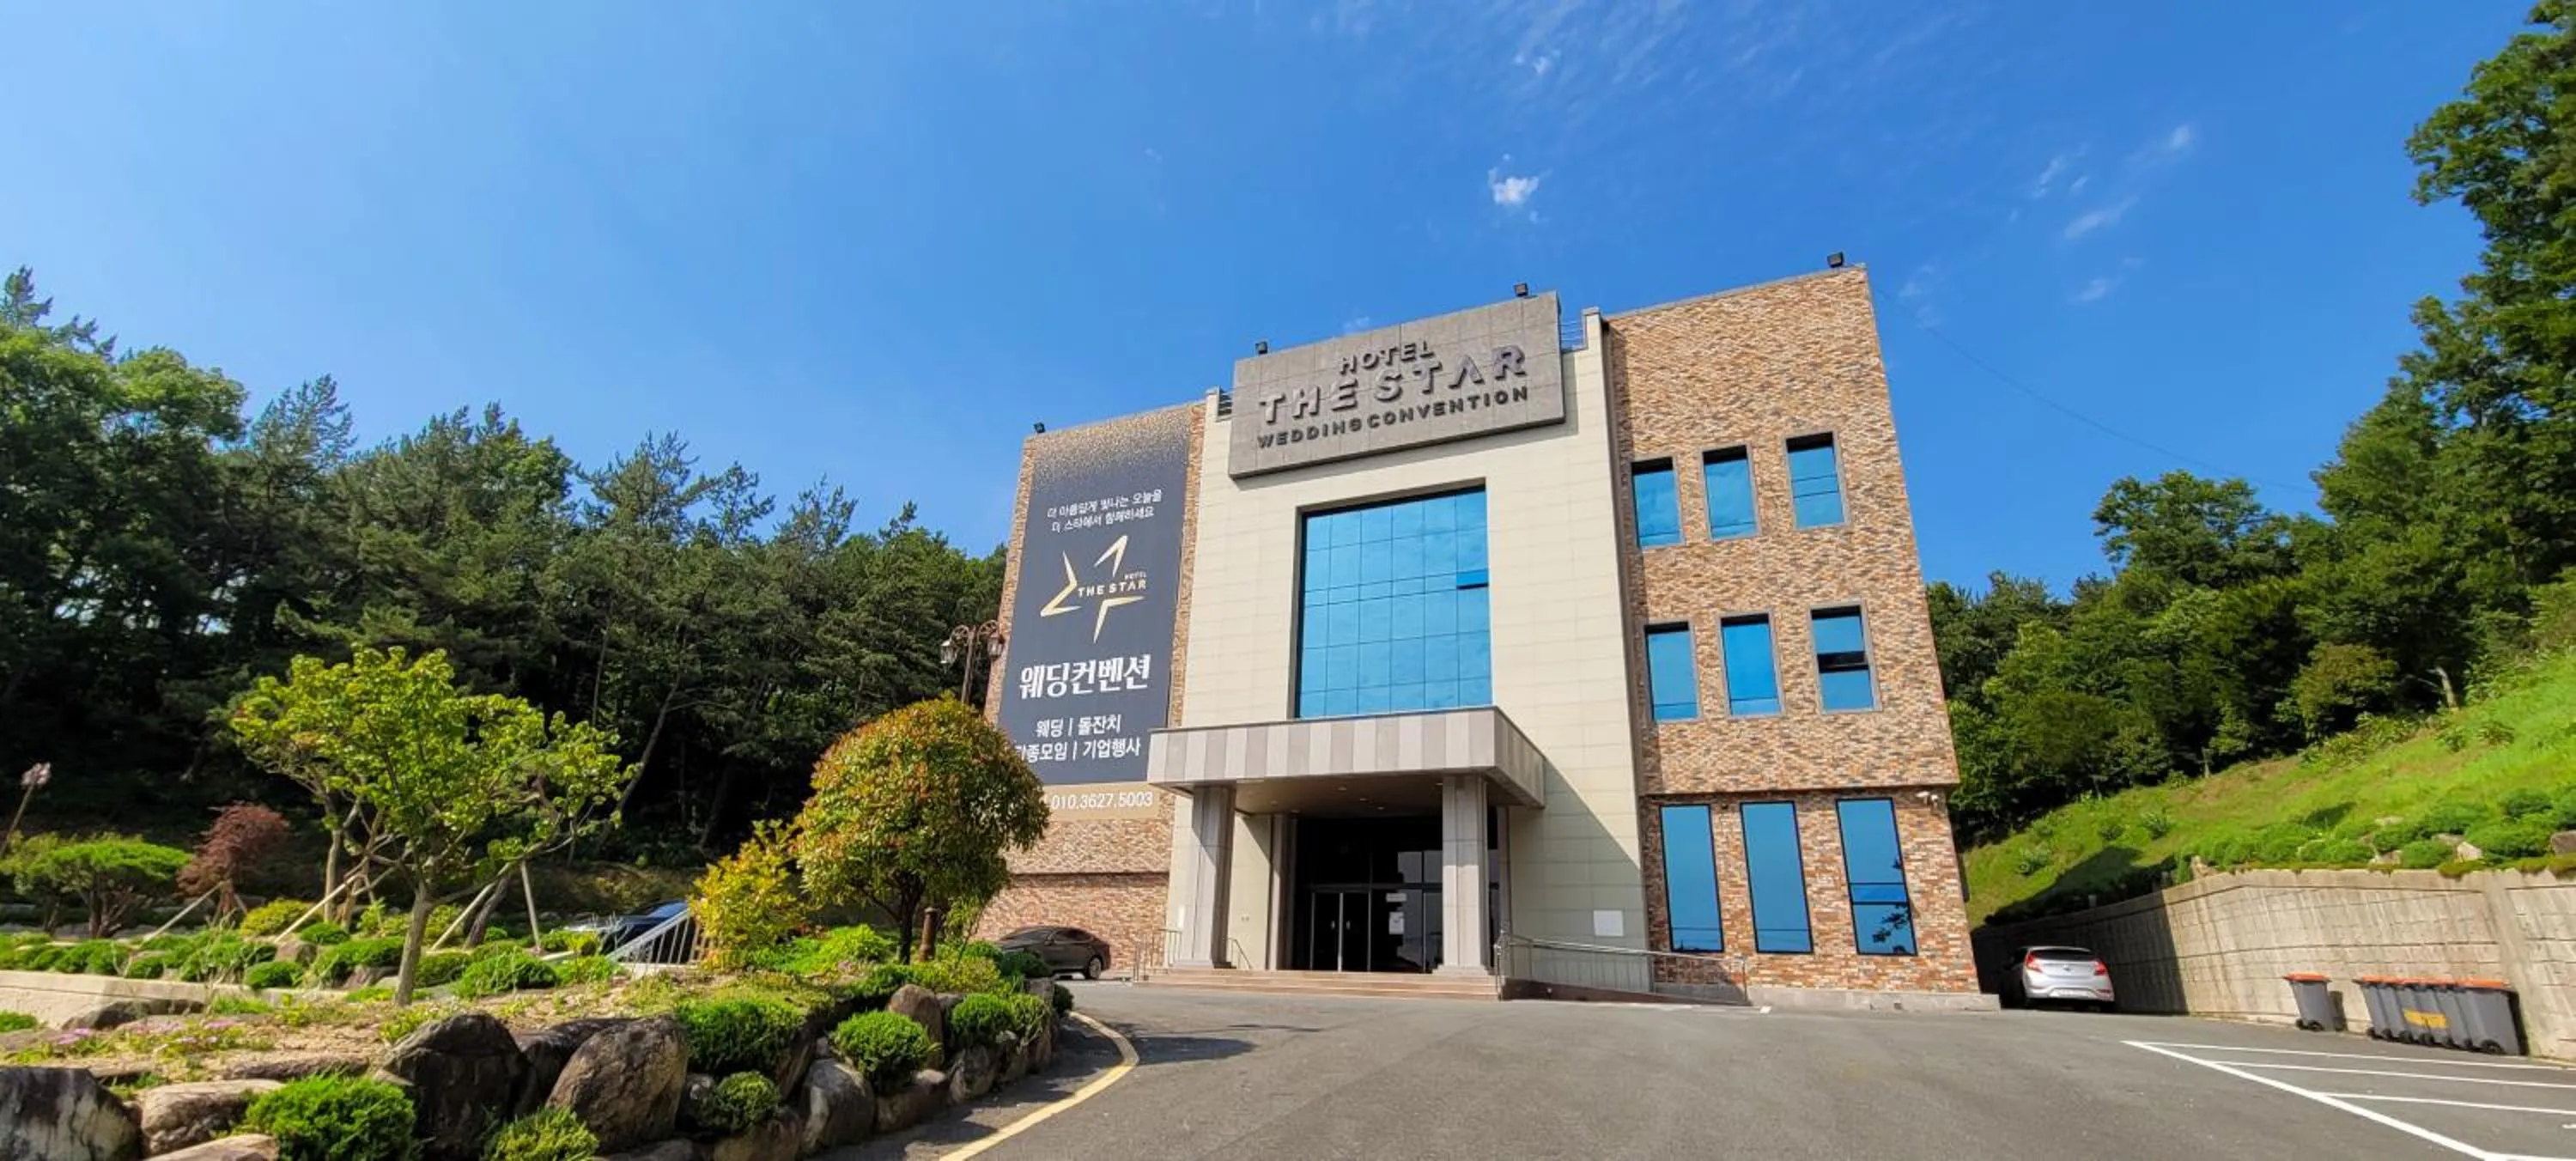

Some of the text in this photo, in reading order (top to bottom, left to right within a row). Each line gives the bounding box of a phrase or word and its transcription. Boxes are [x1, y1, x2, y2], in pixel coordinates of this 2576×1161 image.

[1340, 341, 1435, 375] HOTEL
[1259, 345, 1528, 425] THE STAR
[1257, 386, 1528, 448] WEDDING CONVENTION
[1047, 508, 1057, 519] 더
[1059, 501, 1098, 517] 아름답게
[1100, 496, 1129, 511] 빛나는
[1052, 506, 1154, 533] 더 스타에서 함께하세요
[1078, 579, 1147, 599] THE STAR
[1019, 653, 1151, 700] 웨딩컨벤션
[1036, 717, 1064, 739] 웨딩
[1078, 714, 1121, 736] 돌잔치
[1083, 736, 1140, 760] 기업행사
[1051, 791, 1153, 811] 010.3627.5003
